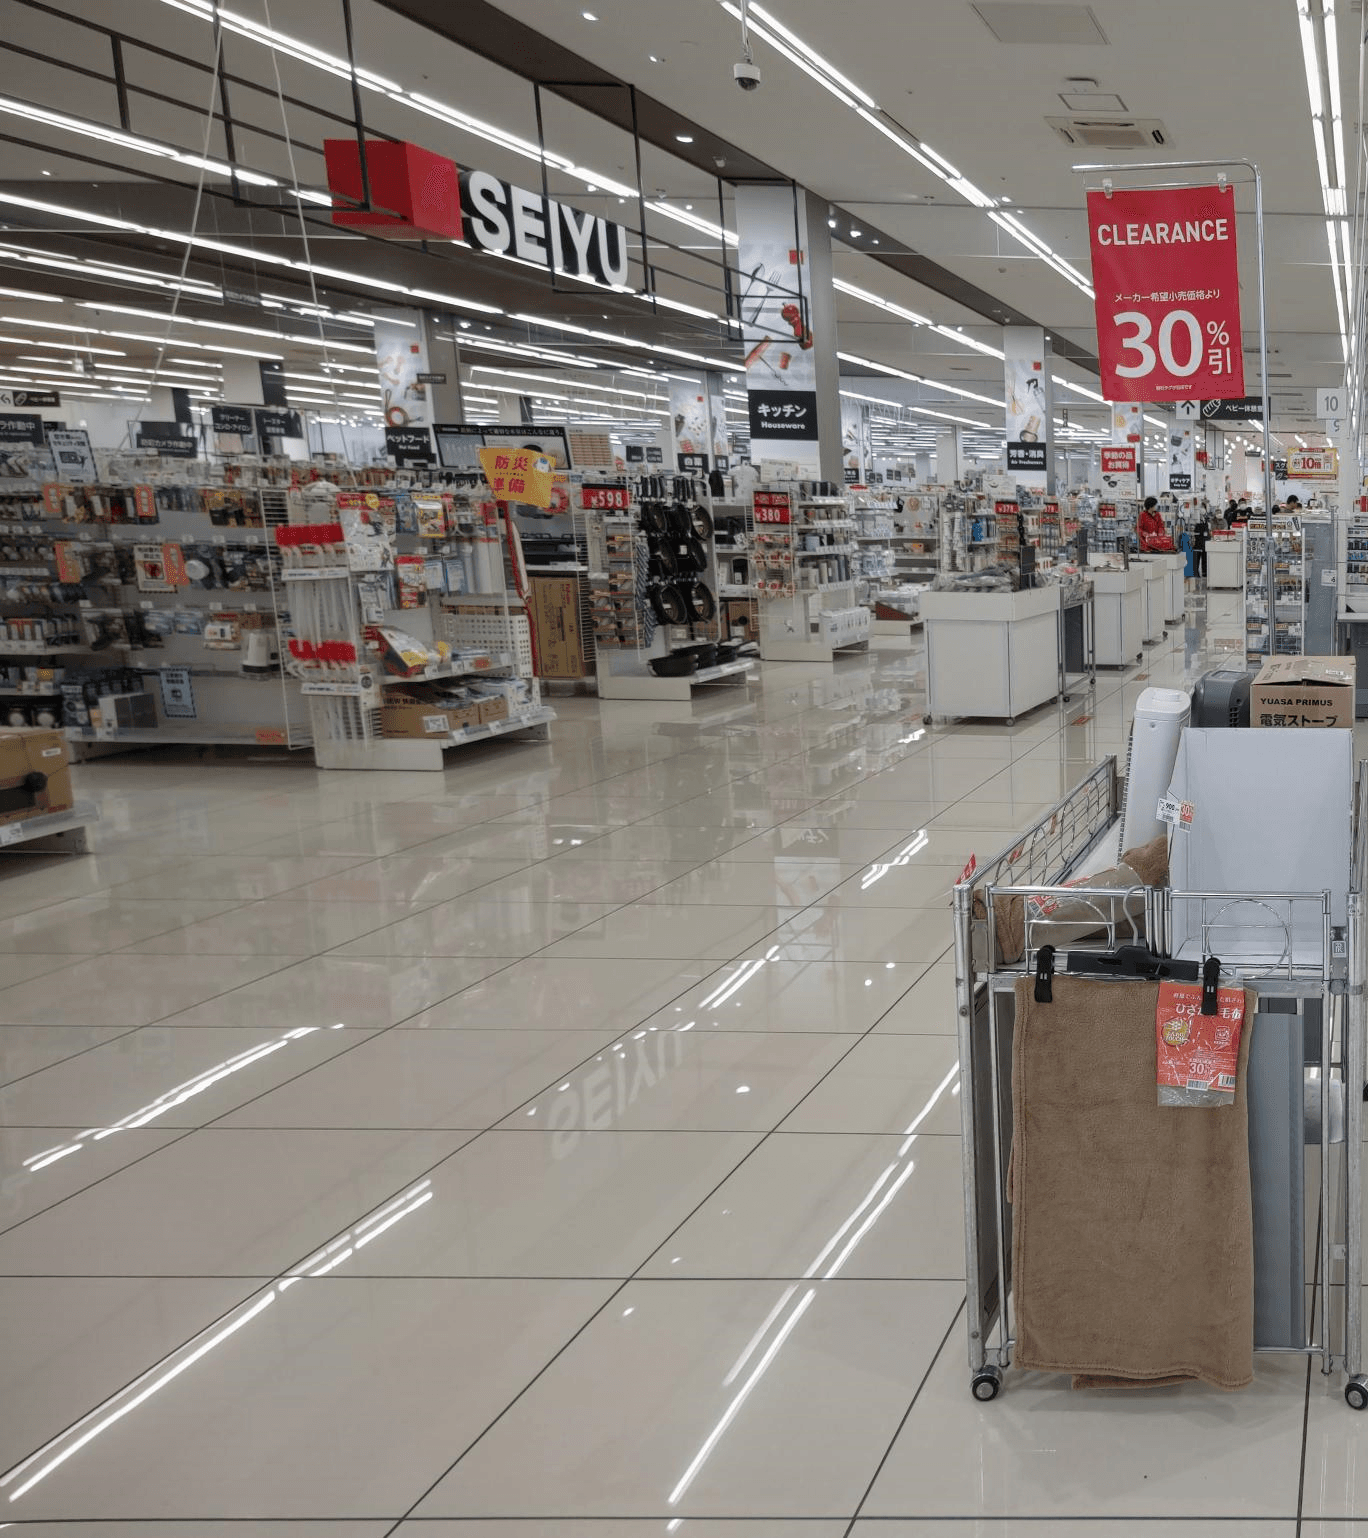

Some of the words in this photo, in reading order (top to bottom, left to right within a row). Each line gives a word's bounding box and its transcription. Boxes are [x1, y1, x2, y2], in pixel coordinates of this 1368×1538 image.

[461, 170, 628, 288] SEIYU
[1097, 218, 1229, 246] CLEARANCE
[1115, 289, 1220, 303] メーカー希望小売価格より
[757, 403, 807, 418] キッチン
[1324, 395, 1339, 412] 10
[760, 420, 806, 430] Houseware
[387, 434, 430, 445] ペットフード
[1009, 449, 1044, 459] 芳香・消臭
[494, 455, 529, 471] 防災
[1260, 698, 1294, 706] YUASA
[1295, 699, 1333, 707] PRIMUS
[1260, 714, 1338, 728] 電気ストーブ
